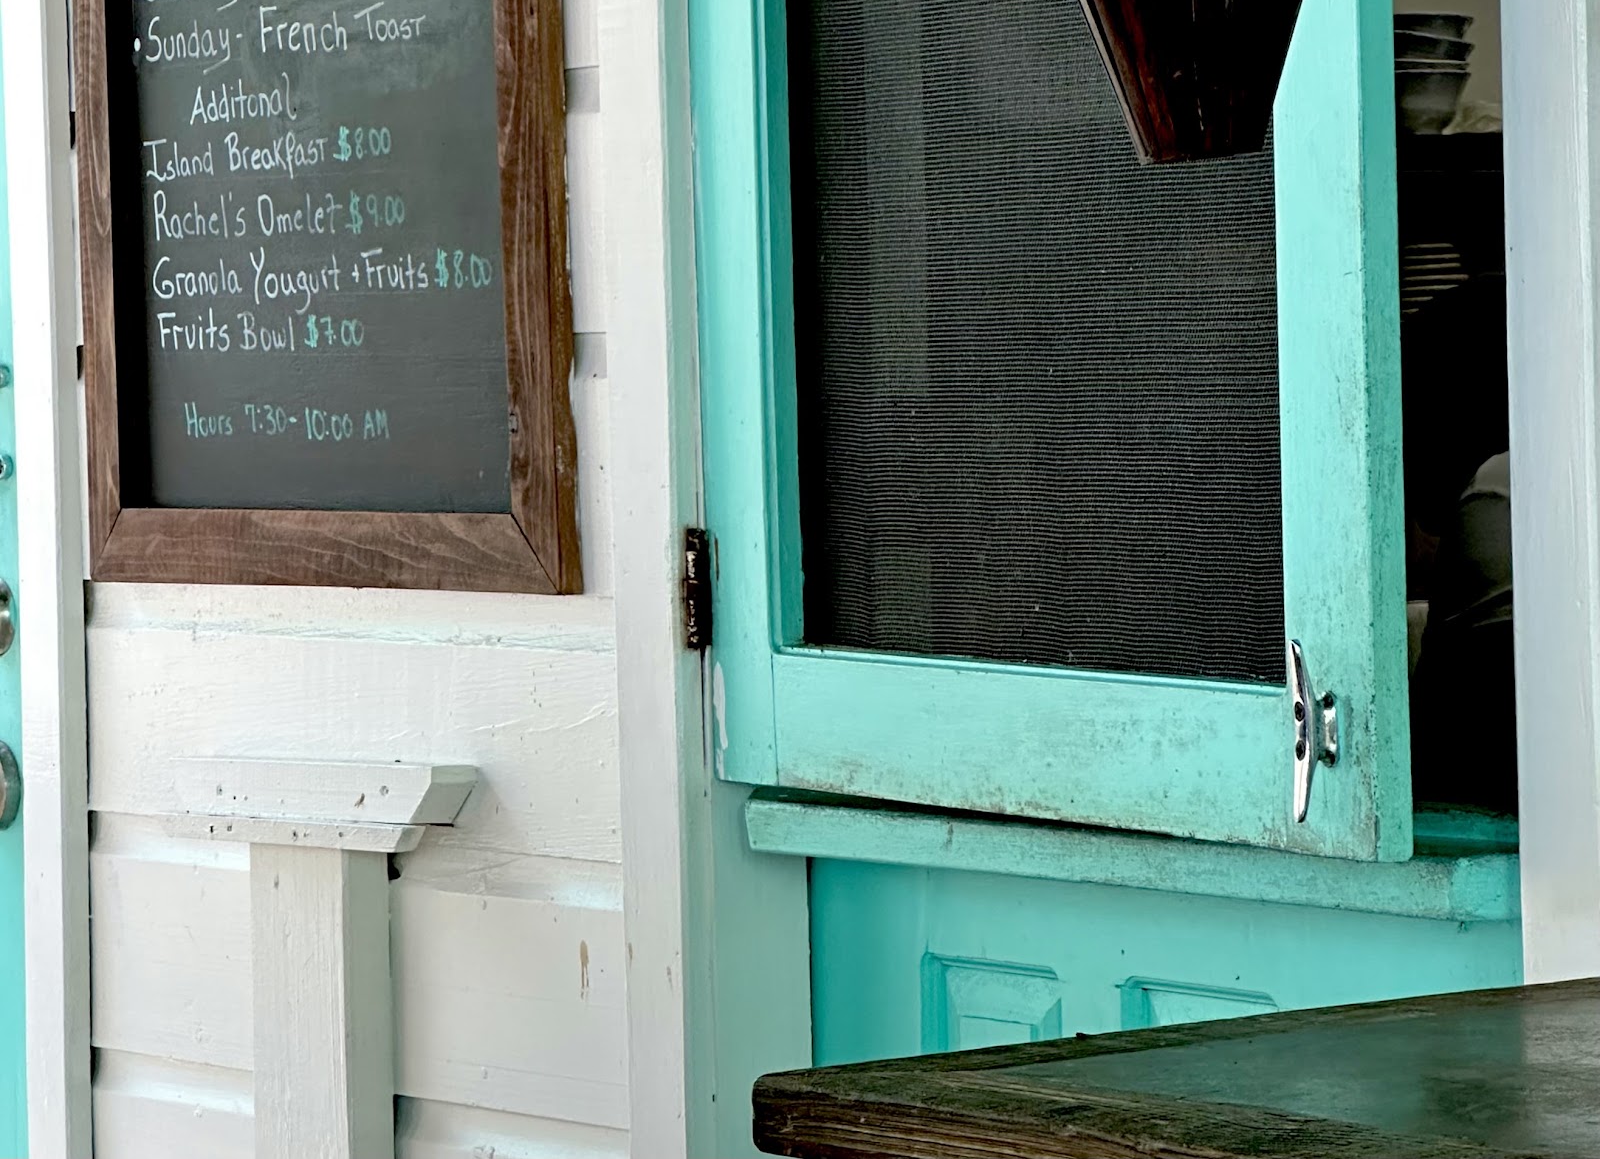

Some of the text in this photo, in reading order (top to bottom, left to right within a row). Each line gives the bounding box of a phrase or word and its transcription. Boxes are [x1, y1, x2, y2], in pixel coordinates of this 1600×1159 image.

[259, 6, 347, 53] French
[144, 139, 214, 182] Island
[333, 126, 391, 161] $8.00
[154, 190, 405, 241] Rachel's Omelet $9.00
[152, 256, 242, 298] Granola
[361, 247, 429, 289] Fruits
[435, 248, 492, 288] $8.00
[156, 307, 364, 351] Fruits Bowl $7.00
[184, 402, 233, 438] Hours
[363, 408, 390, 439] AM
